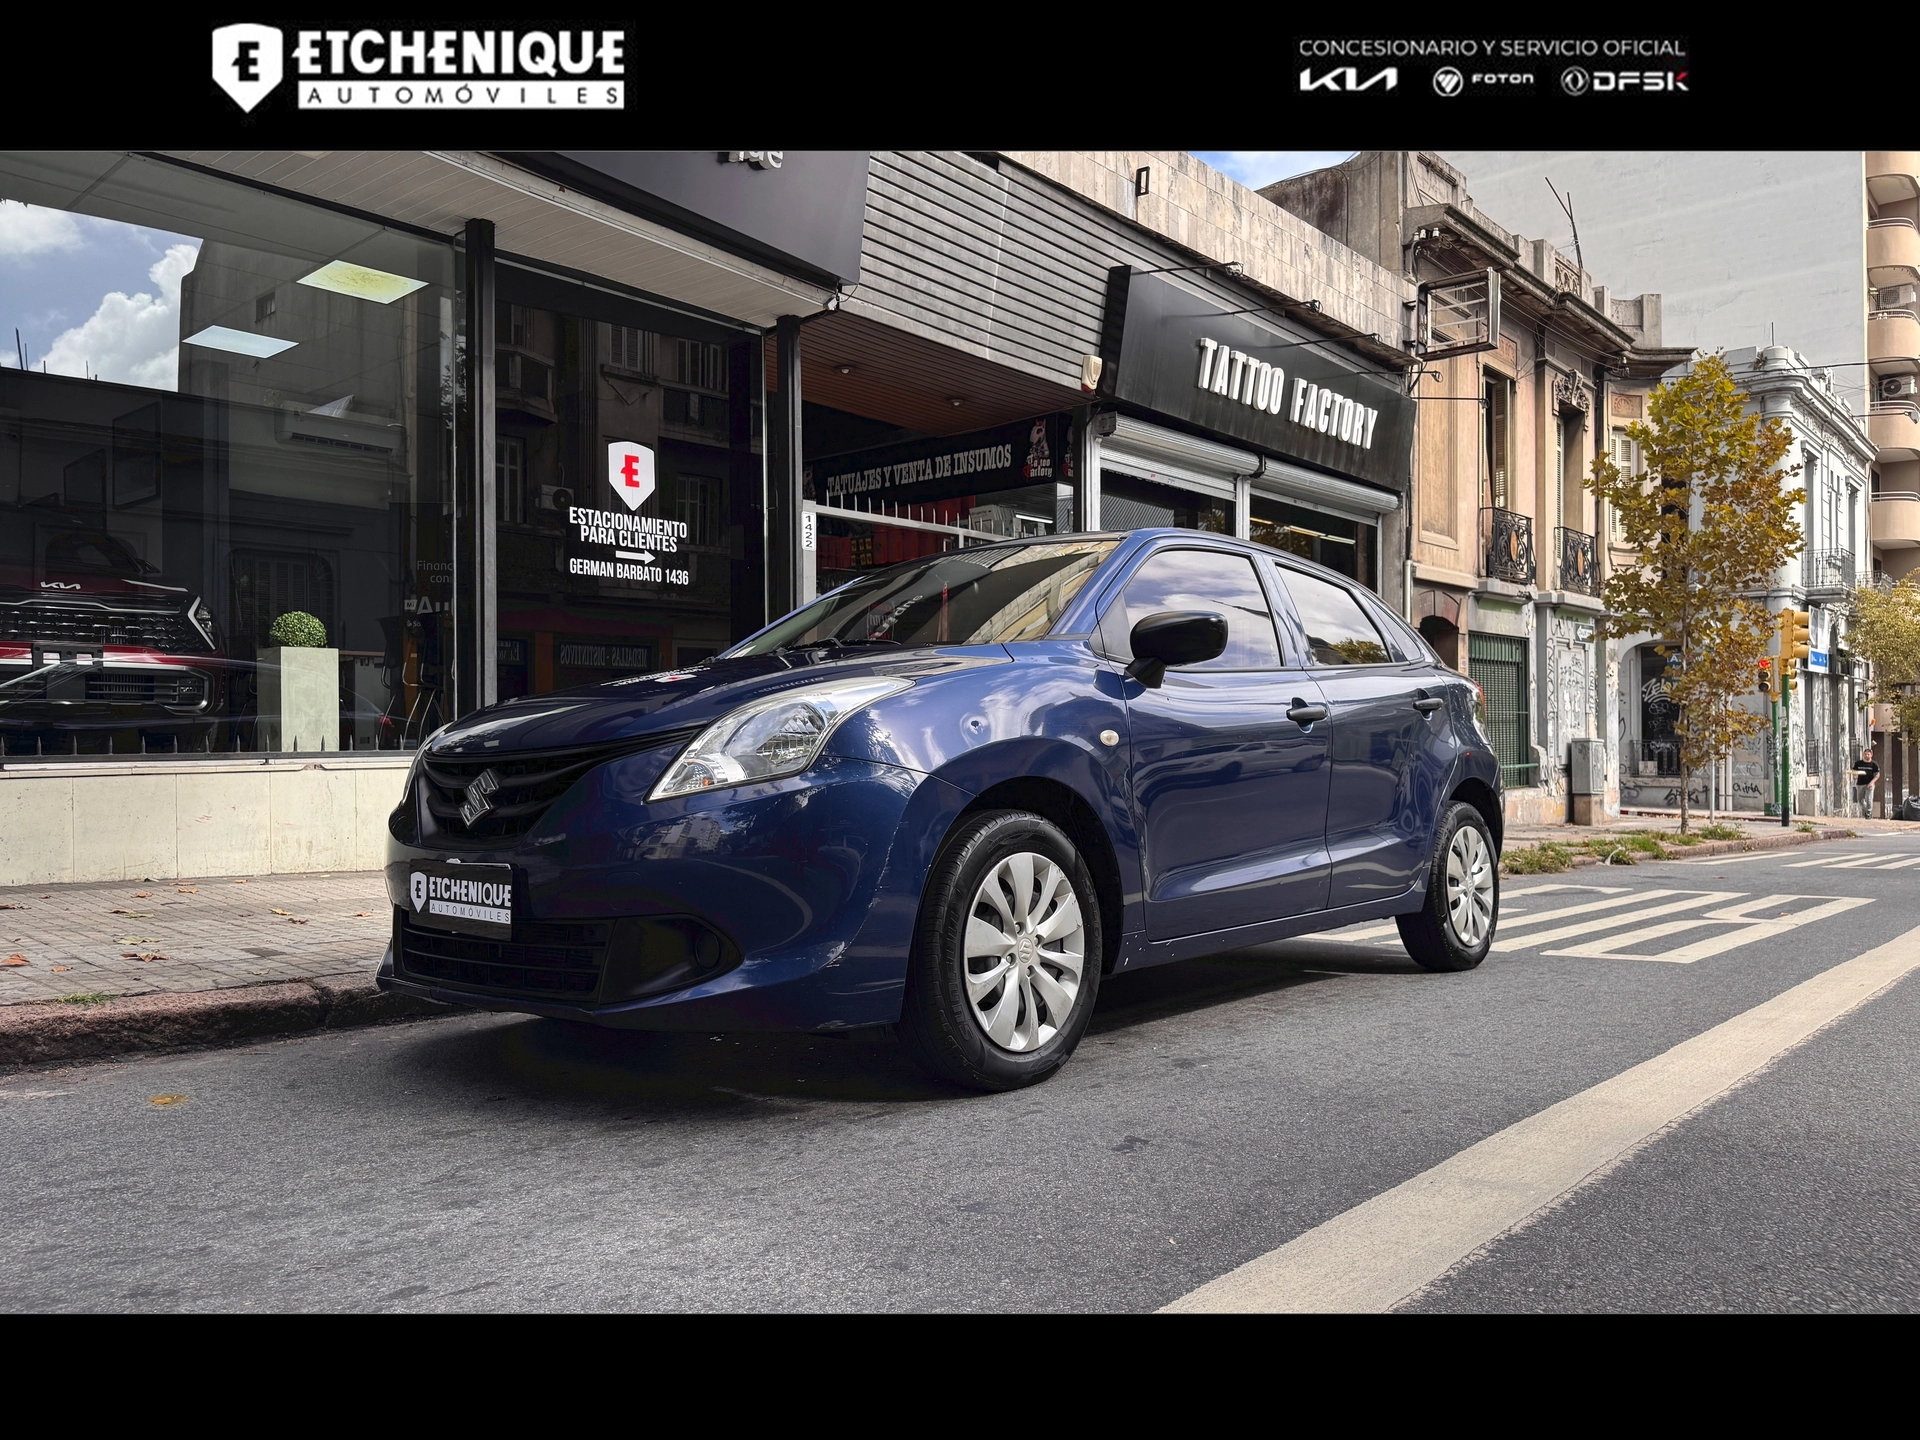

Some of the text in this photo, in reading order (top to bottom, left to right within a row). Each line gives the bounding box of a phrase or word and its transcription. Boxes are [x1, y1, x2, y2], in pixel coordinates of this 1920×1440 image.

[1197, 337, 1378, 450] TATTOO FACTORY
[827, 444, 1012, 497] TATUAJES Y VENTA DE INSUMOS
[569, 506, 688, 539] ESTACIONAMIENTO
[580, 524, 677, 553] PARA CLIENTES
[569, 558, 689, 585] GERMAN BARBATO 1436
[429, 876, 511, 907] ETCHENIQUE
